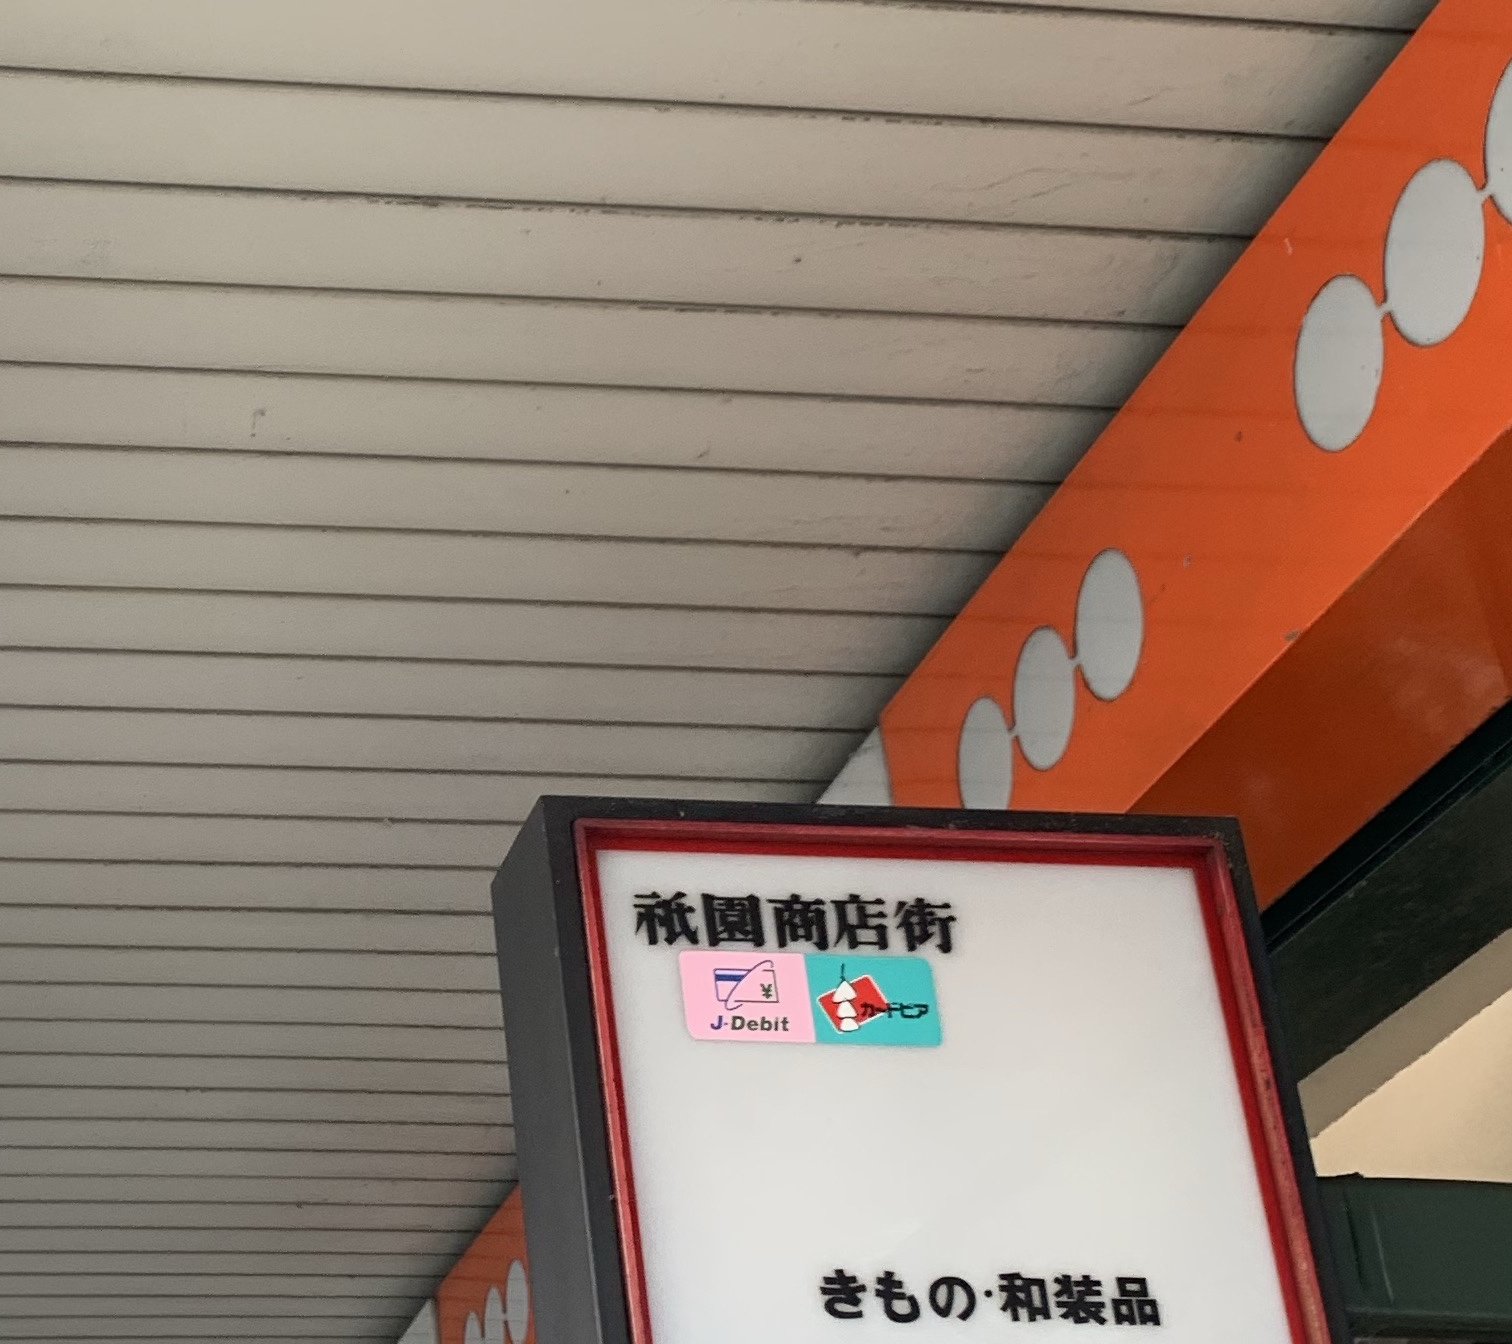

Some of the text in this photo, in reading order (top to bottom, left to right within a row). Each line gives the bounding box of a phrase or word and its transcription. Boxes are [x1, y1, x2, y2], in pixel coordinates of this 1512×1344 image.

[632, 890, 957, 954] 祇園商店街
[710, 1014, 790, 1033] J-Debit
[820, 1268, 1162, 1327] きもの・和装品
